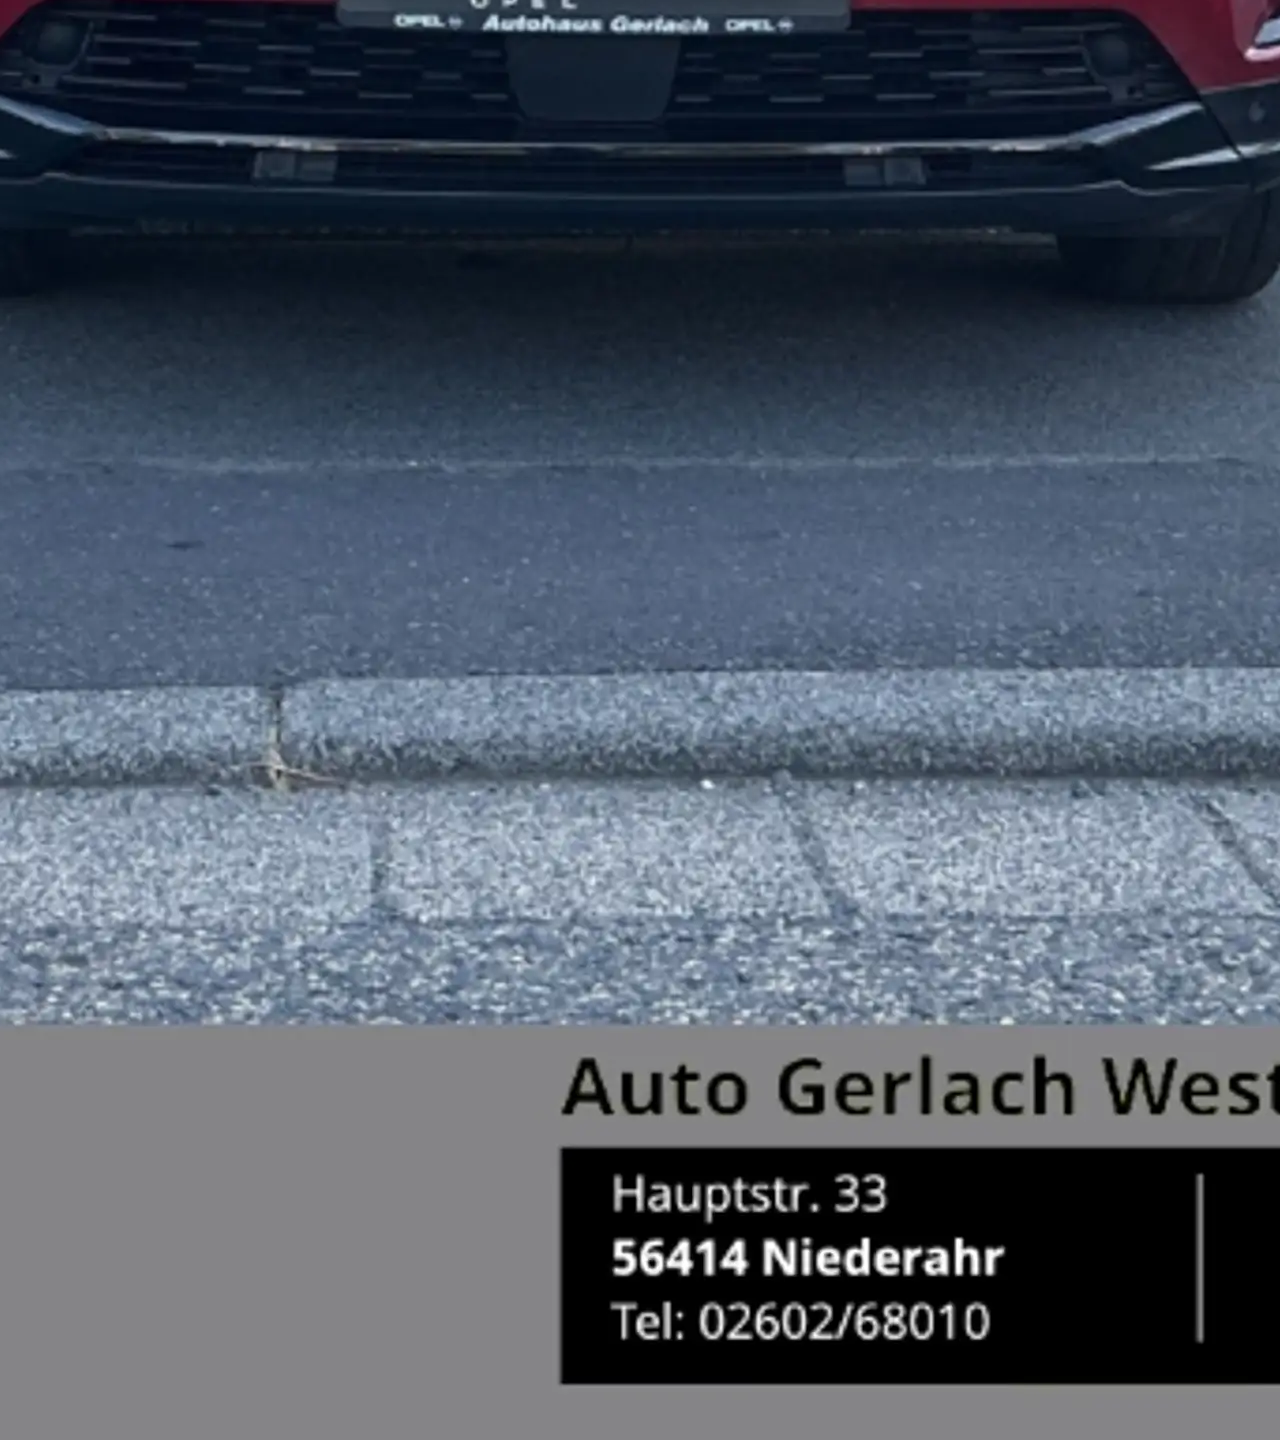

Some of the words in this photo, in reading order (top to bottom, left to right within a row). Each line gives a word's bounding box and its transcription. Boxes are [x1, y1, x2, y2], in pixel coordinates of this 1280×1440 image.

[394, 13, 445, 28] OPEL
[482, 14, 602, 32] Autohaus
[610, 14, 709, 34] Gerlach
[725, 17, 775, 33] OPEL
